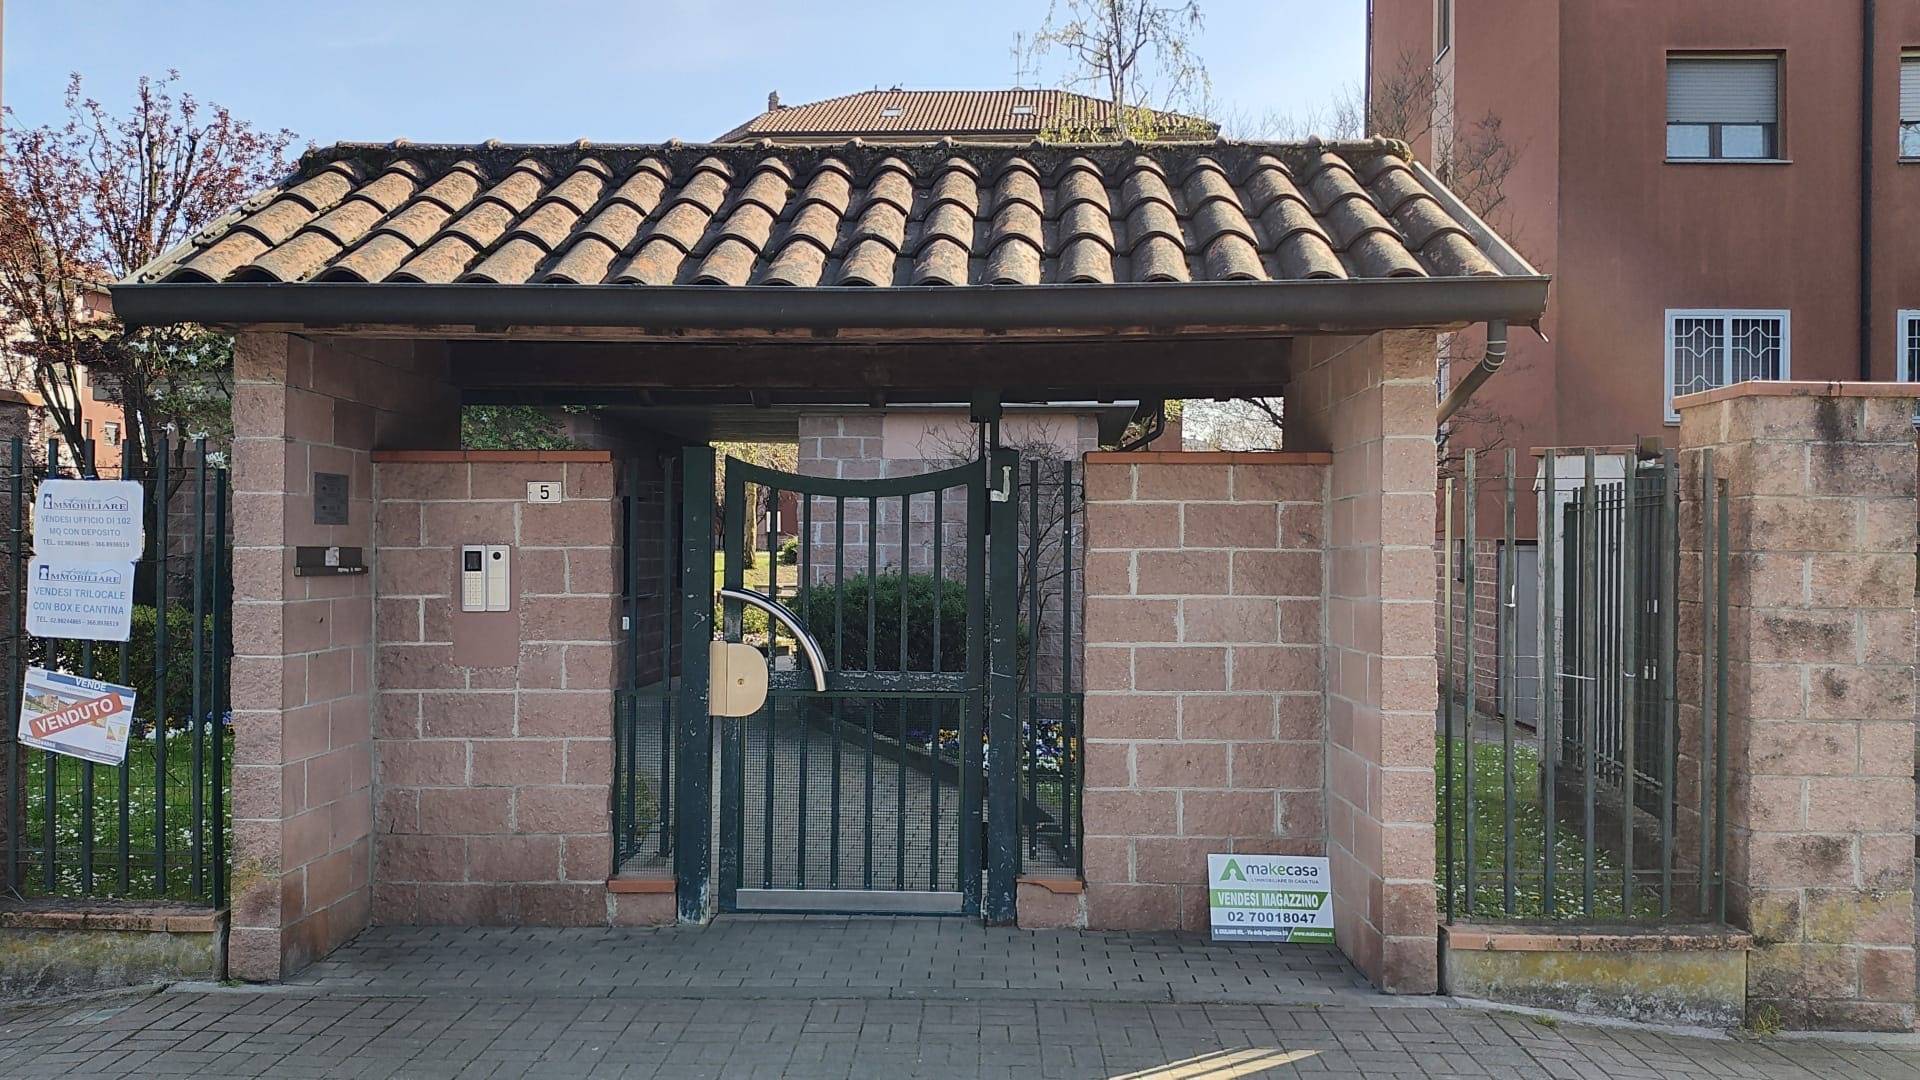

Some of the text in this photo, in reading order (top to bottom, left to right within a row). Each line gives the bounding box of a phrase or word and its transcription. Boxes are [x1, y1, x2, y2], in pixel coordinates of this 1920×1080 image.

[540, 485, 549, 499] 5
[41, 515, 131, 525] VENDESI UFFICIO DI 102
[49, 528, 121, 537] MQ CON DEPOSITO
[33, 587, 126, 600] VENDESI TRILOCALE
[33, 601, 124, 615] CON BOX E CANTINA
[74, 677, 107, 692] VENDE
[35, 698, 113, 733] VENDUTO
[1246, 862, 1319, 877] makecasa
[1218, 891, 1319, 908] VENDESI MAGAZZINO
[1227, 911, 1316, 924] 02 70018047
